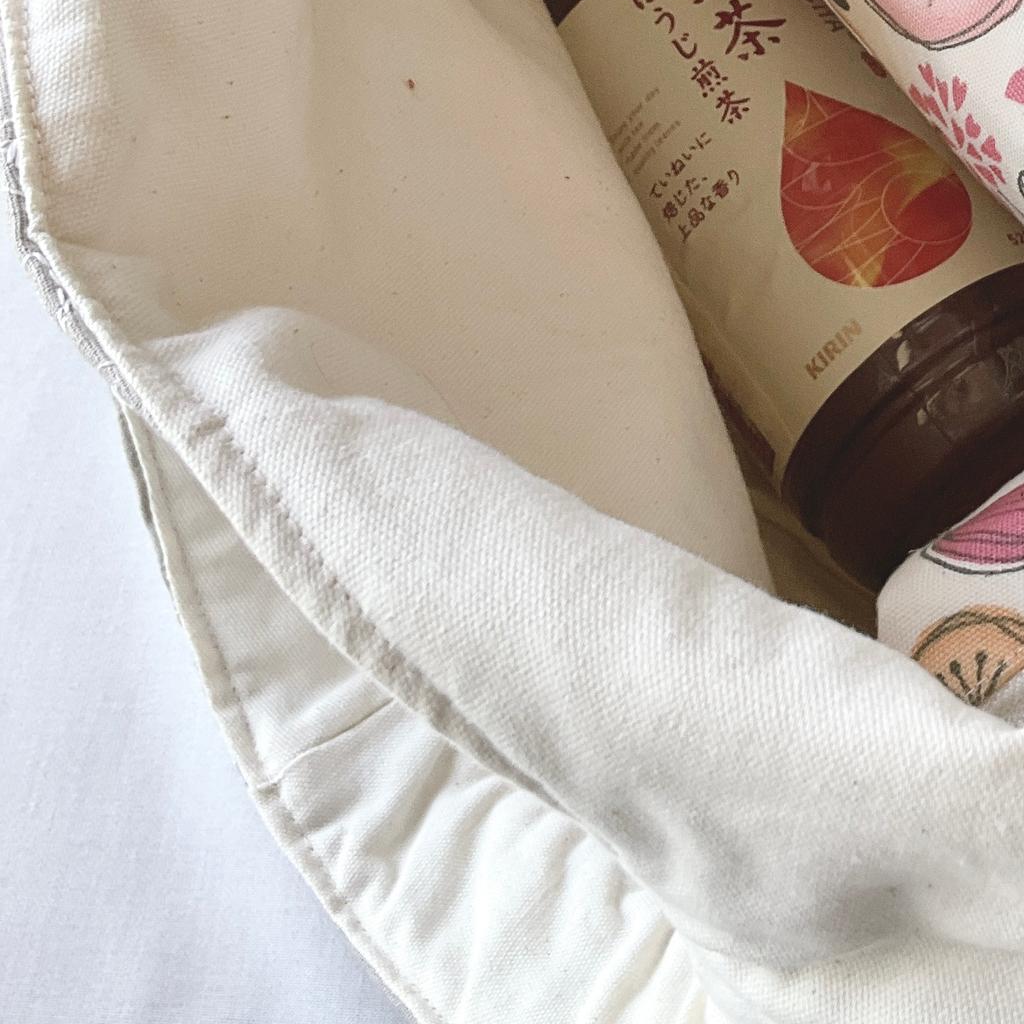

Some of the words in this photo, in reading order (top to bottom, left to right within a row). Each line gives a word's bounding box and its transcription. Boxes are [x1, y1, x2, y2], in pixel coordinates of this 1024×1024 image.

[649, 131, 713, 200] ていねいに
[677, 169, 741, 243] 上品な香り
[804, 318, 863, 381] KIRIN
